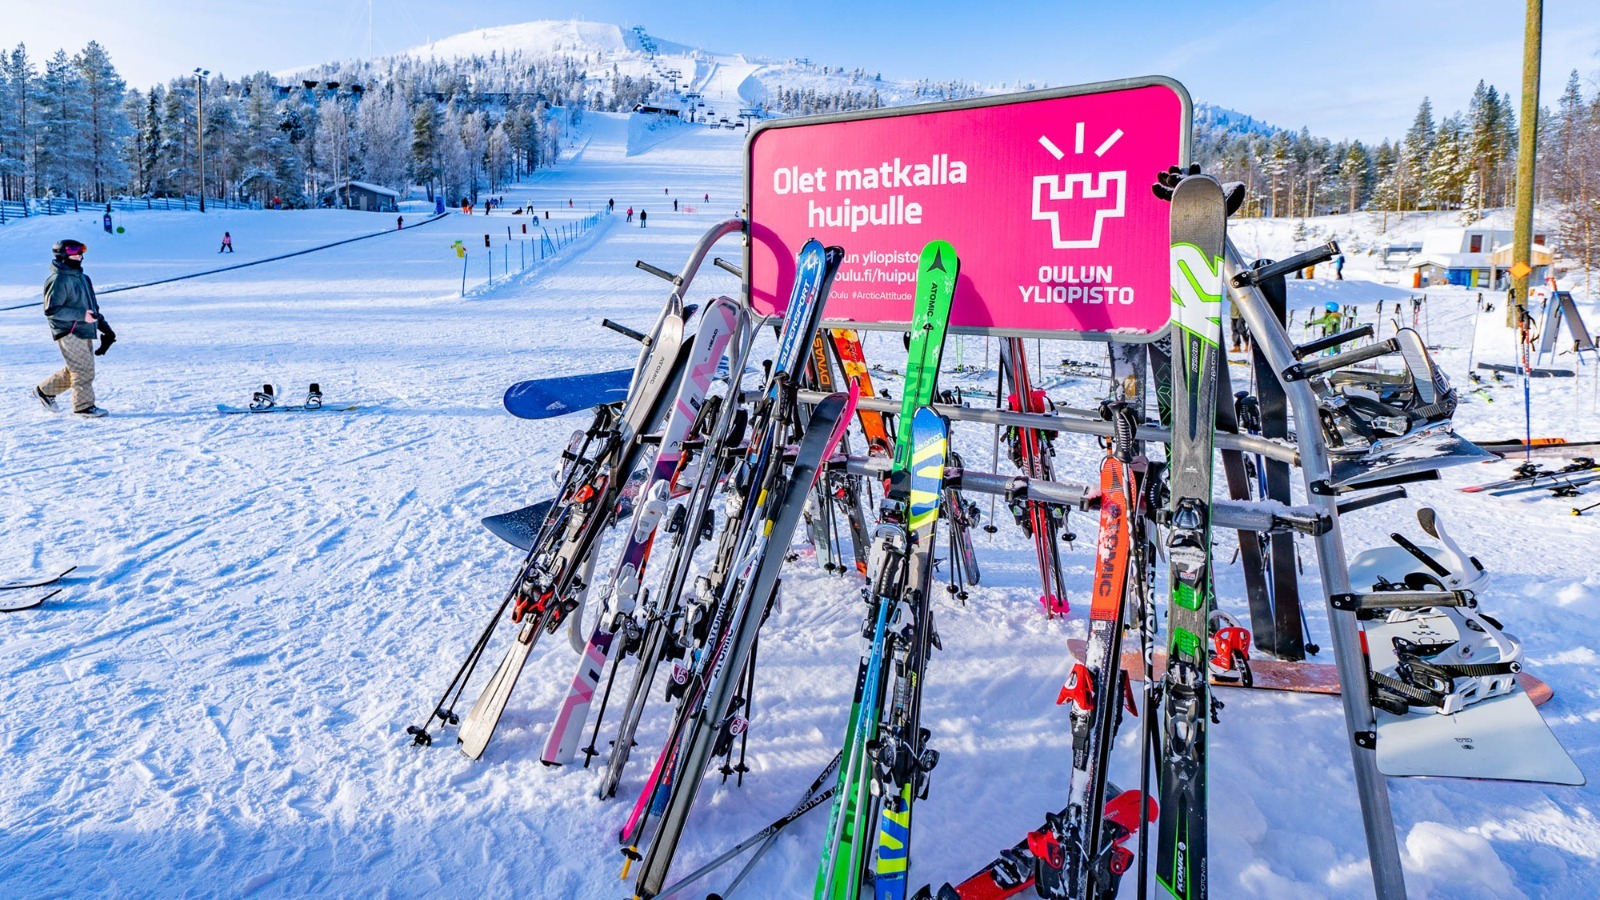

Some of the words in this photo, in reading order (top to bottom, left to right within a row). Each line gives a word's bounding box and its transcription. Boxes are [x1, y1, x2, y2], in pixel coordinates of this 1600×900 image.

[773, 166, 827, 194] Olet
[835, 153, 967, 191] matkalla
[808, 195, 923, 232] huipulle
[862, 250, 920, 267] yliopisto
[1038, 265, 1113, 284] OULUN
[834, 268, 919, 285] oulu.fi/huipul
[828, 290, 849, 299] Oulu
[852, 291, 912, 301] #ArcticAttitude
[926, 282, 938, 317] ATOMIC
[1018, 285, 1135, 305] YLIOPISTO
[707, 328, 719, 351] HEAD
[780, 281, 811, 366] SUPERSPORT
[650, 355, 665, 385] ATOMIC
[813, 329, 831, 385] DYNAS
[1098, 503, 1122, 597] ATOMIC
[707, 598, 728, 646] ATOMIC
